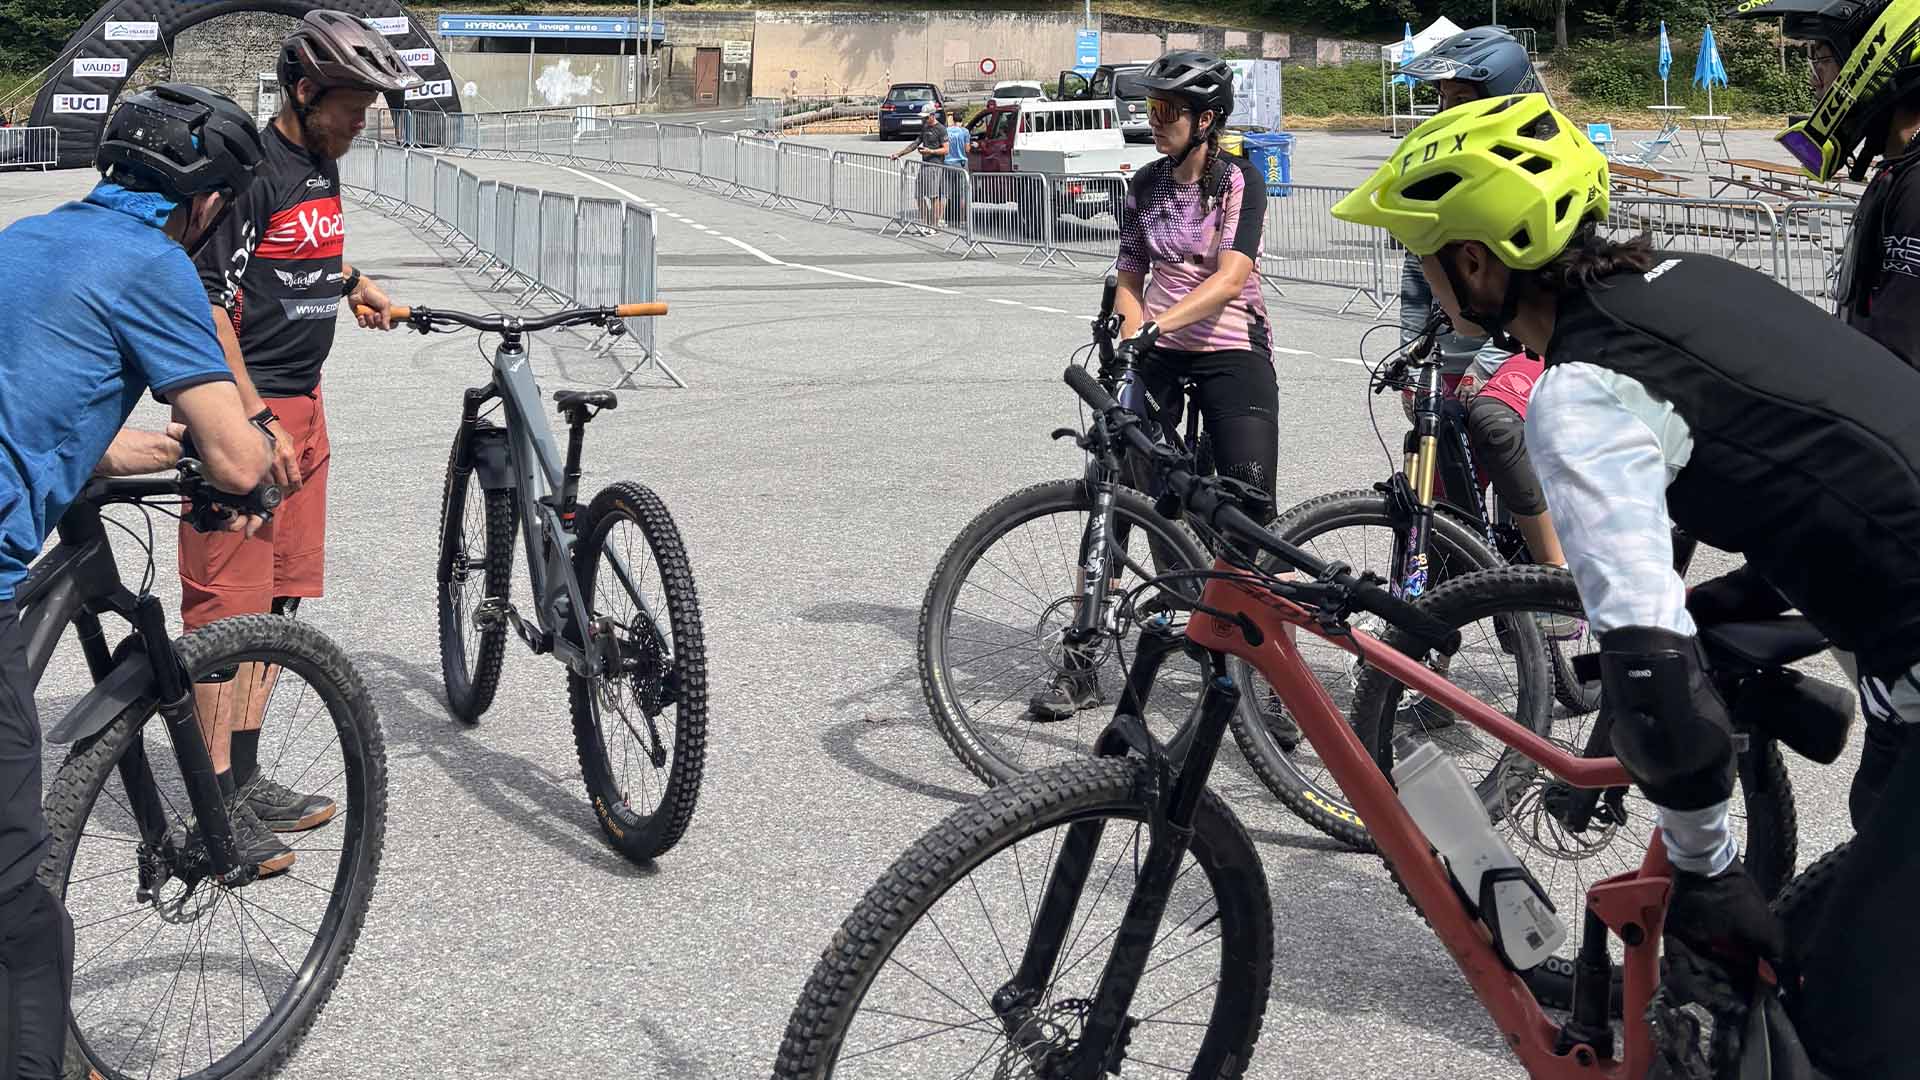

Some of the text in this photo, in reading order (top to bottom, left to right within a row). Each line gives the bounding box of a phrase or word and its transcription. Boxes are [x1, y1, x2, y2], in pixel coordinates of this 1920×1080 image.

[464, 21, 598, 32] HYPROMAT lavage auto
[400, 53, 421, 62] AUD
[82, 63, 112, 72] VAUD
[1819, 23, 1887, 128] KENNY
[420, 83, 446, 96] UCI
[69, 97, 101, 111] UCI
[1401, 132, 1468, 177] FOX
[943, 701, 985, 756] PURGATORY
